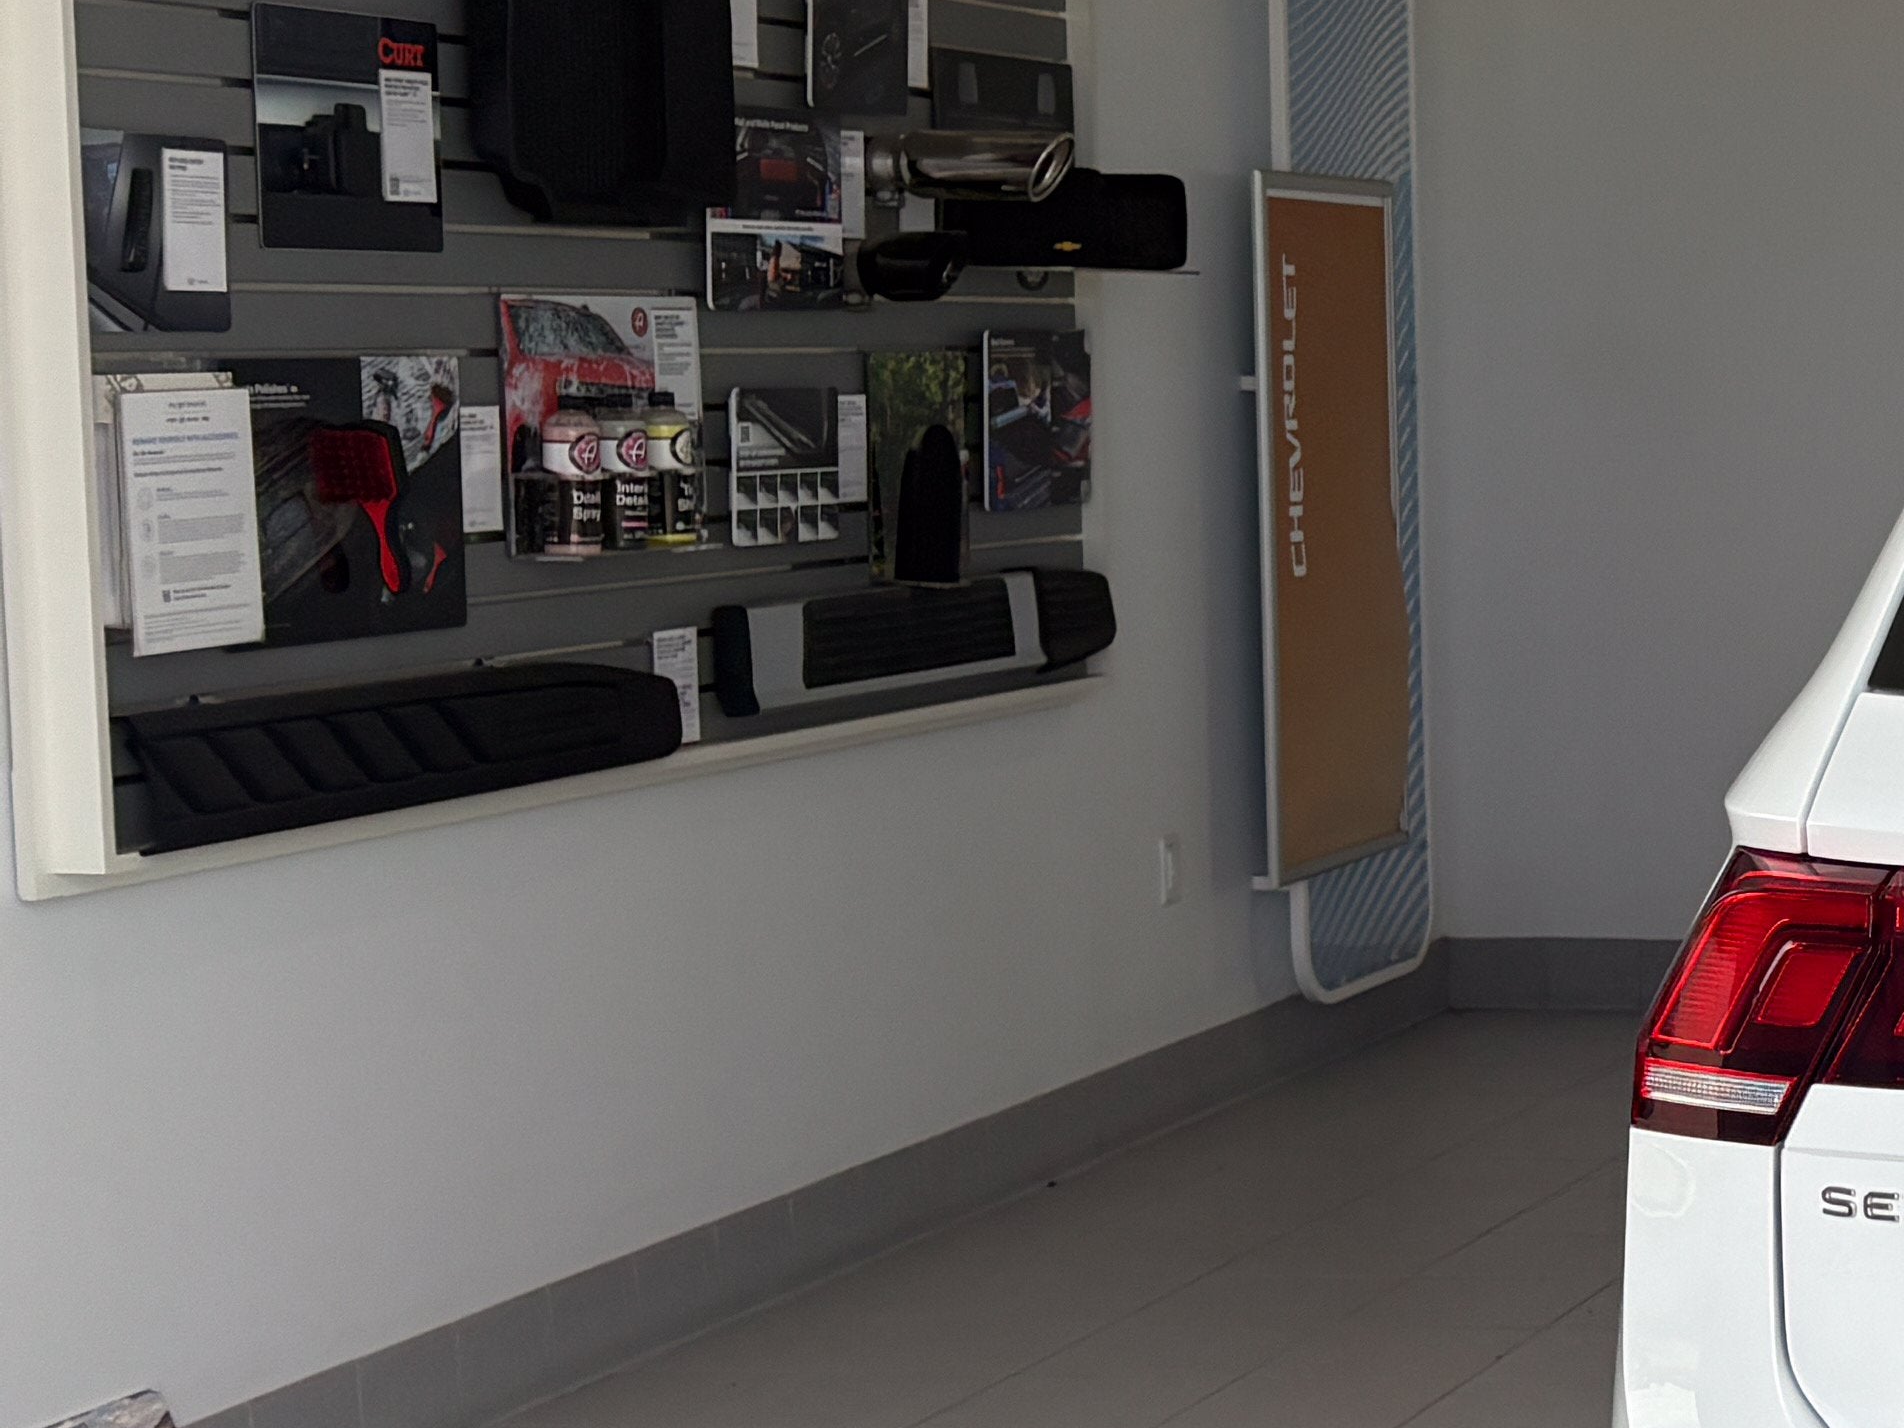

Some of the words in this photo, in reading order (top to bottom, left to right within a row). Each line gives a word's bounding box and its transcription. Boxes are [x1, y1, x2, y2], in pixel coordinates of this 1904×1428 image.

[377, 36, 426, 67] CURT
[1281, 252, 1308, 578] CHEVROLET
[1821, 1185, 1901, 1223] SE
